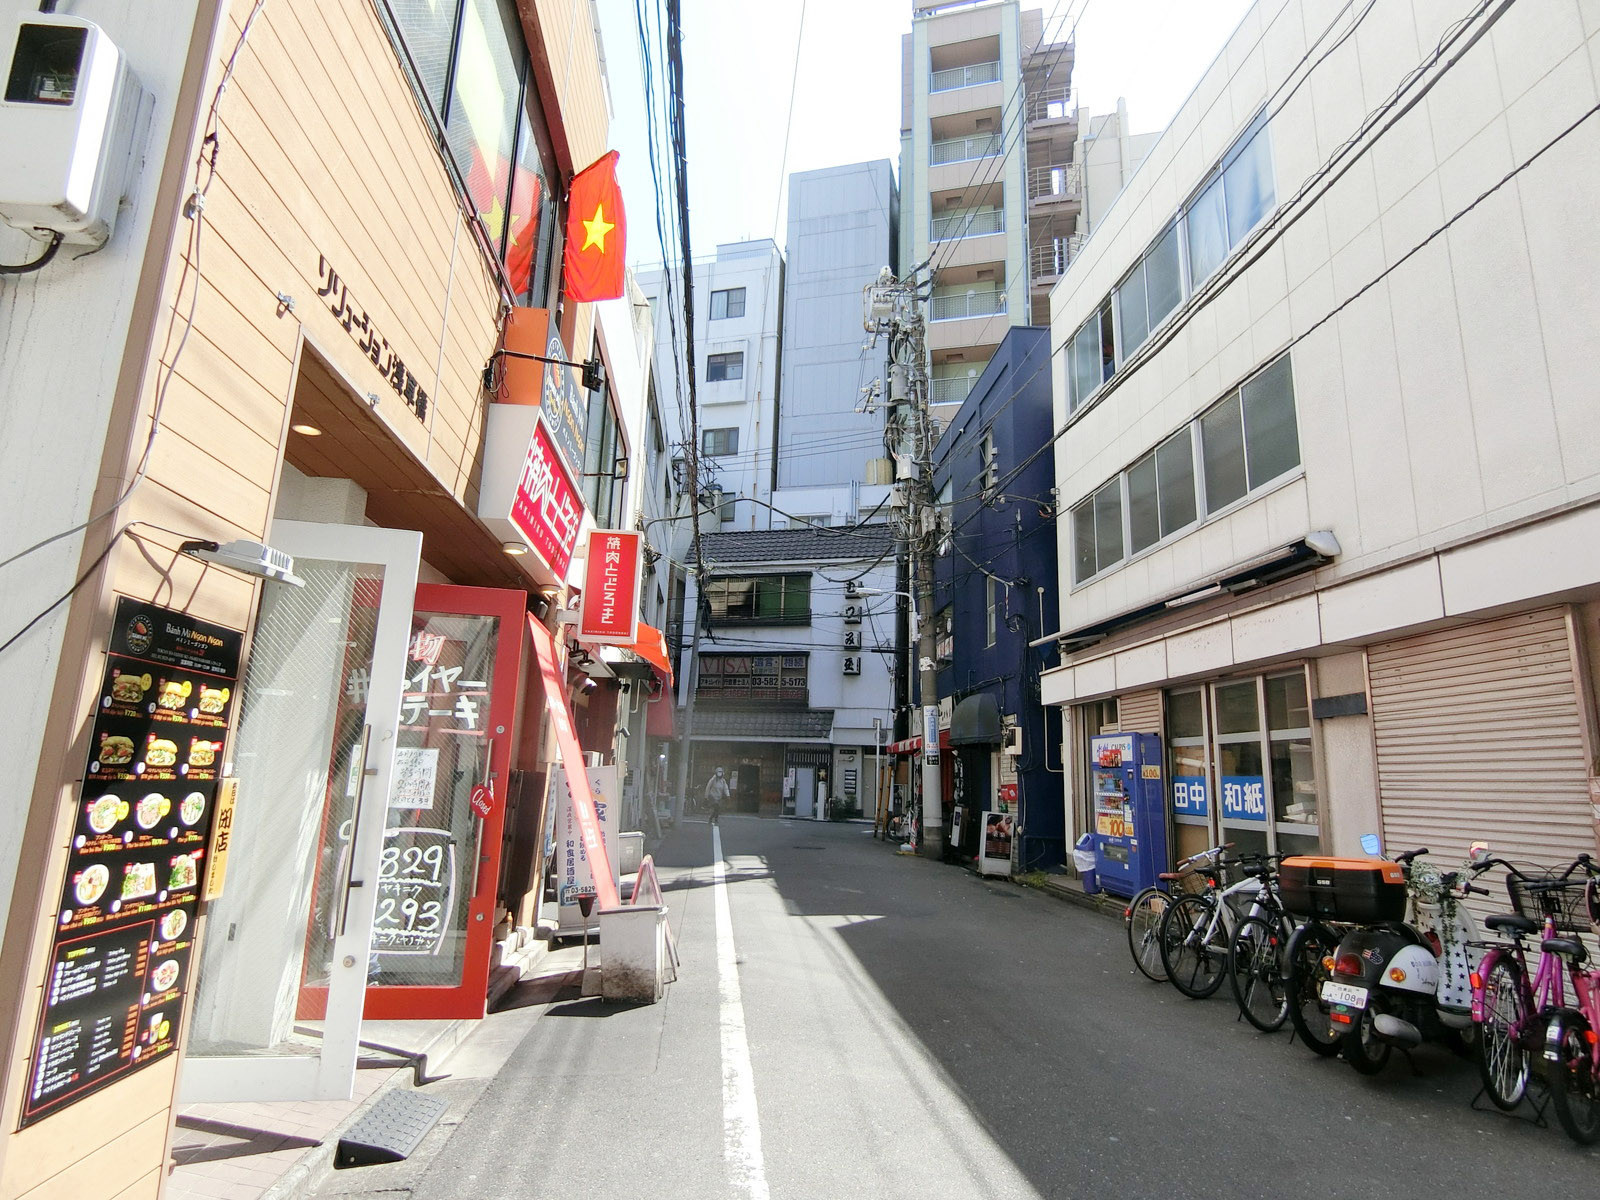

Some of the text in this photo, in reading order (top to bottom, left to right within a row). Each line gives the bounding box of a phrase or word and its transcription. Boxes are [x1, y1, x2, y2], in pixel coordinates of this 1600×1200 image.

[601, 536, 622, 625] 焼肉とどろき
[703, 657, 749, 673] VISA
[400, 695, 479, 729] テーキ
[472, 788, 492, 815] Closed
[1174, 782, 1263, 814] 田中 和紙
[566, 839, 575, 885] 和食居酒屋
